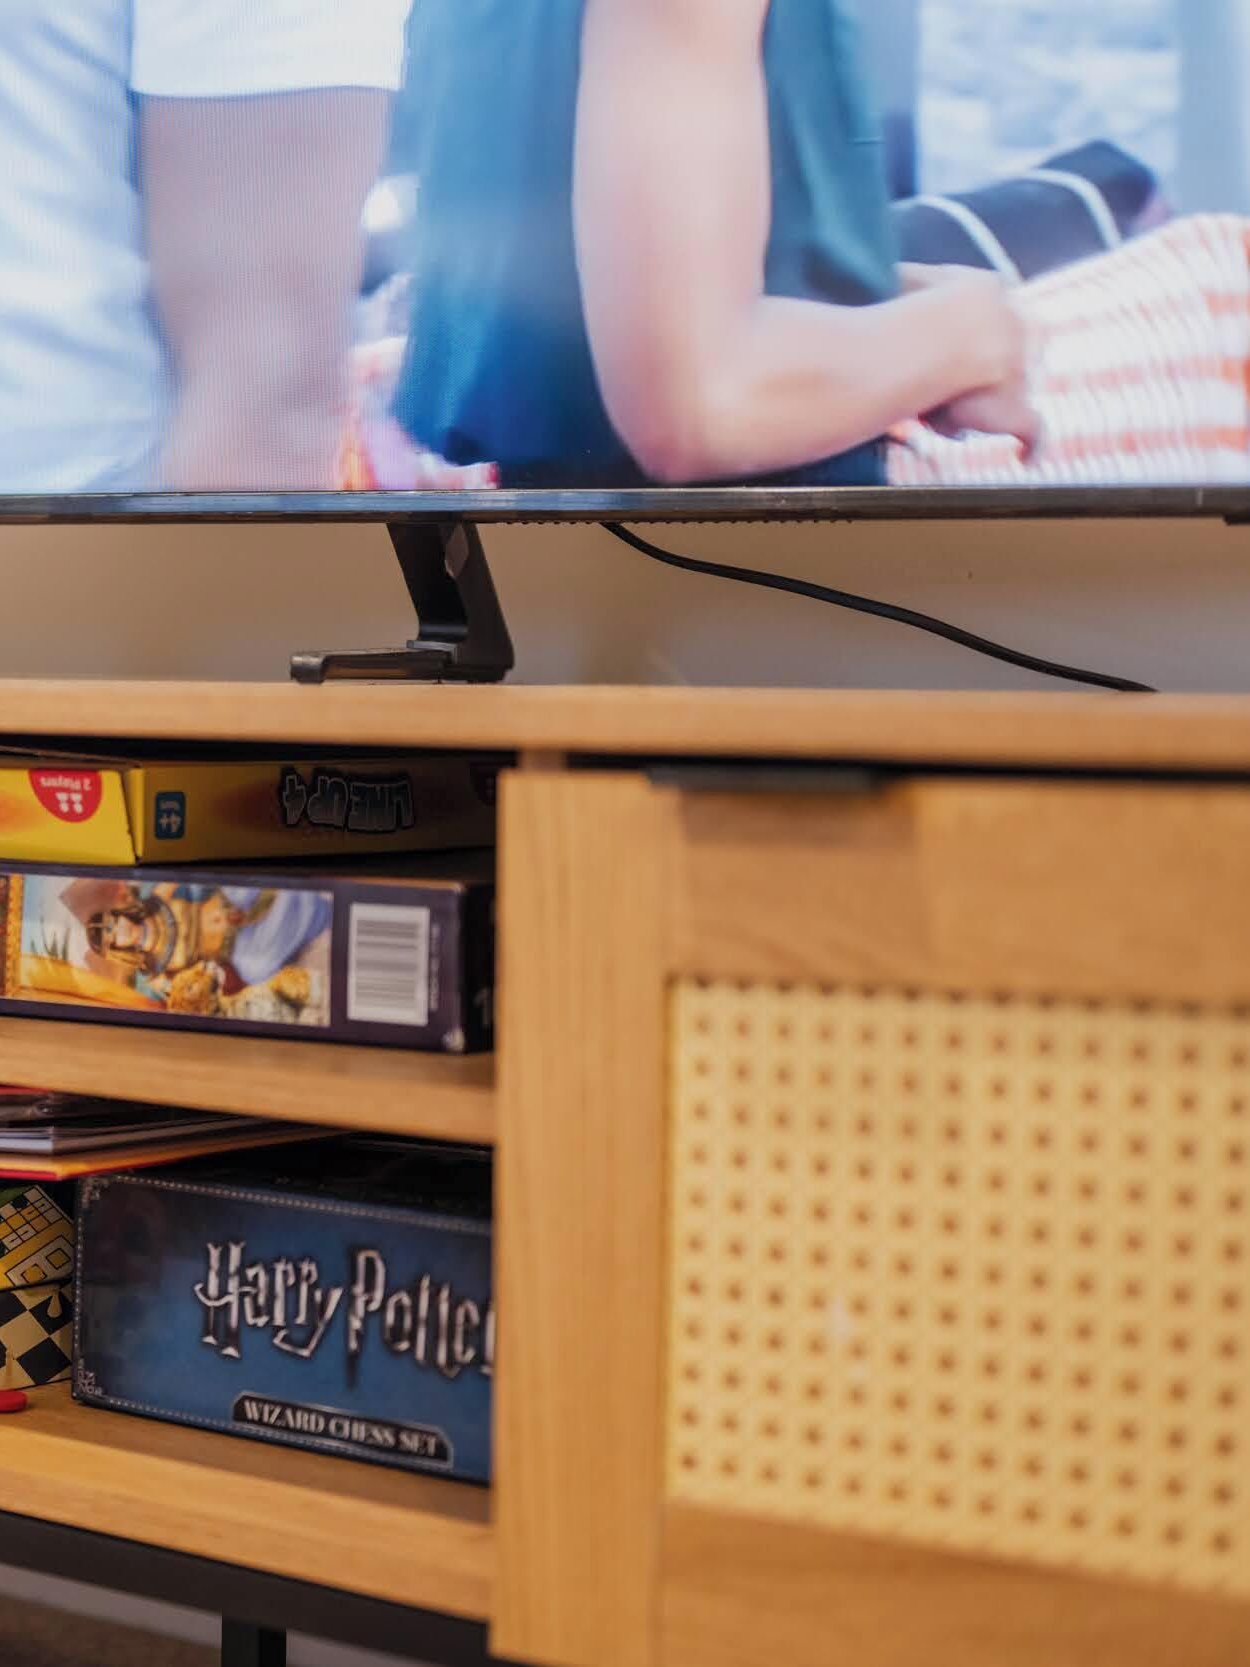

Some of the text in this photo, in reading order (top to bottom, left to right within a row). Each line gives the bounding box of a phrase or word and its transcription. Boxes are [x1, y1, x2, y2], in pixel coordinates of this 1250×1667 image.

[39, 776, 93, 792] 2 Players
[282, 774, 415, 833] LINE UP 4
[194, 1241, 343, 1359] Harry
[243, 1399, 437, 1457] WIZARD CHESS SET
